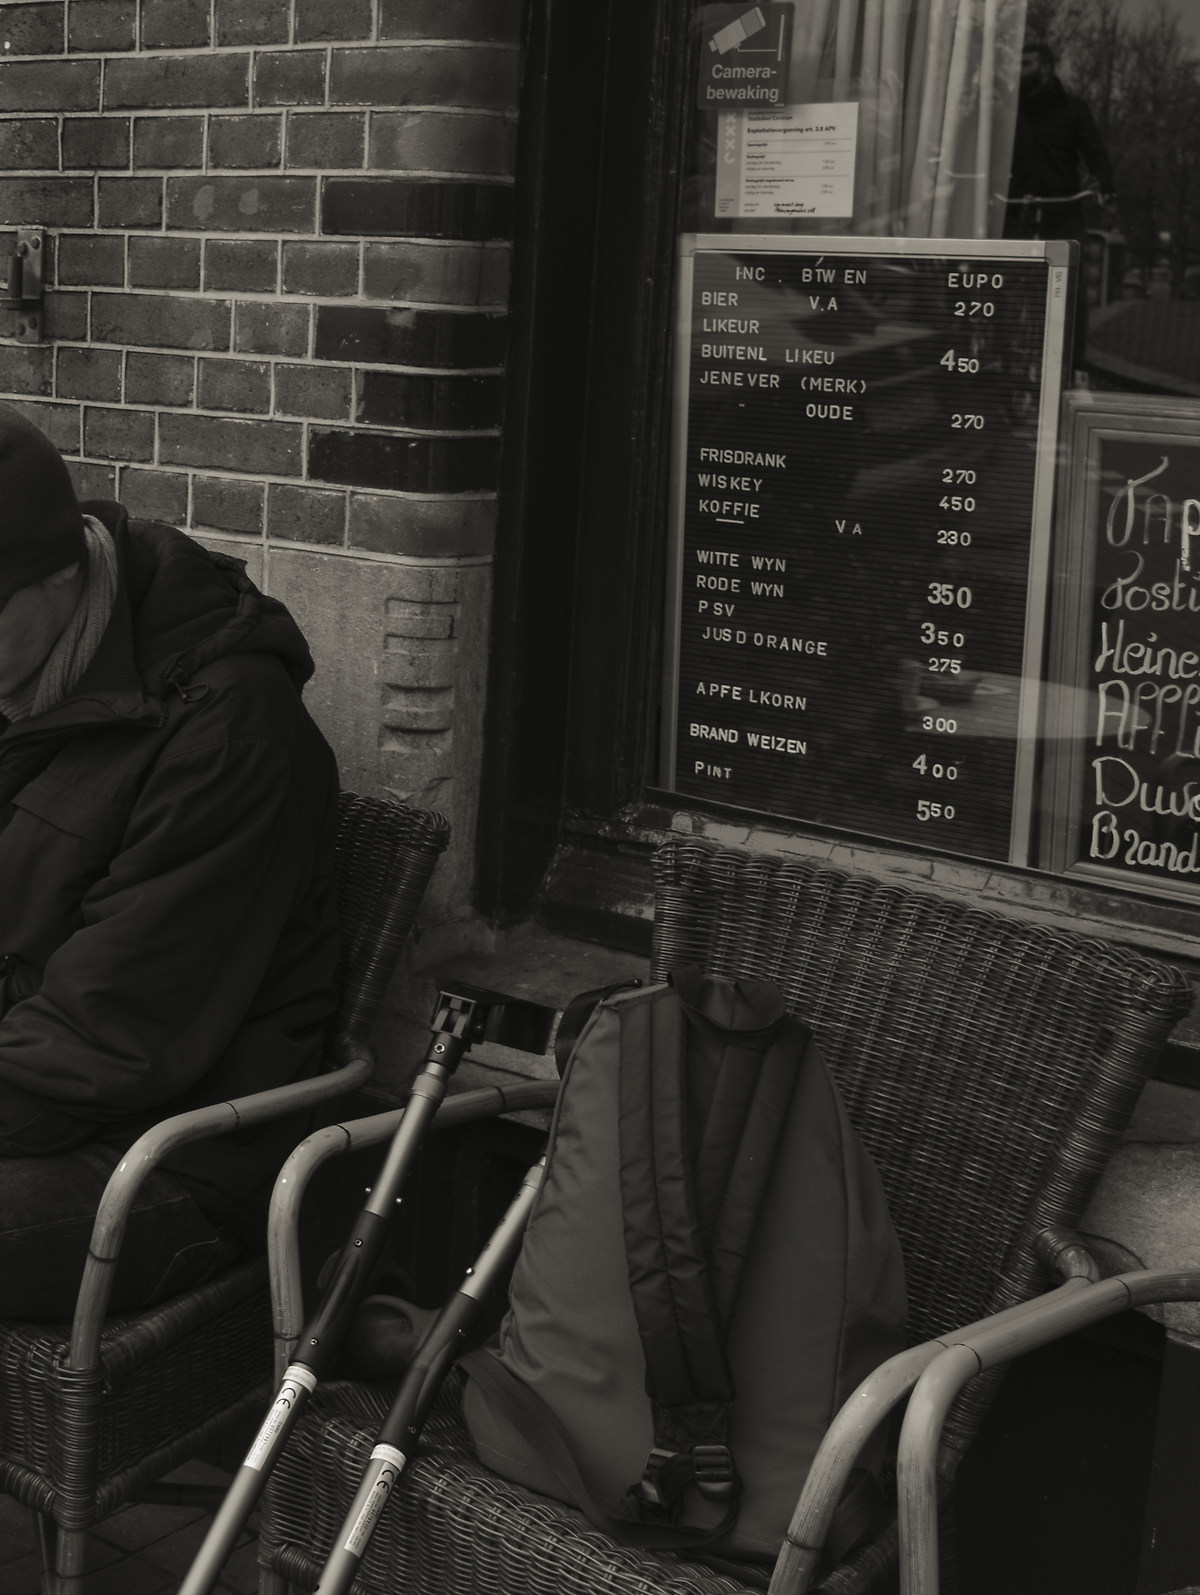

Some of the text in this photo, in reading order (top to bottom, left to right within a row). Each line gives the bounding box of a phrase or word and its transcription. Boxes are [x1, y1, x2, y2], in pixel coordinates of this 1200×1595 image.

[712, 64, 777, 78] Camera-
[706, 85, 779, 102] bewaking
[801, 268, 836, 283] BTW
[844, 269, 867, 285] EN
[701, 291, 738, 307] BIER
[953, 301, 995, 317] 270
[703, 318, 760, 334] LIKEUR
[701, 343, 980, 374] BUITENL LIKEU 450
[800, 376, 867, 394] (MERK)
[805, 403, 985, 430] OUDE 270
[700, 447, 977, 485] FRISDRANK 270
[698, 473, 976, 512] WISKEY 450
[699, 500, 760, 519] KOFFIE
[936, 529, 971, 547] 230
[696, 549, 972, 609] WITTE WYN 350
[696, 574, 965, 648] RODE WYN 350
[753, 632, 828, 656] ORANGE
[1095, 618, 1200, 679] Heine
[928, 657, 962, 675] 275
[923, 717, 957, 733] 300
[689, 723, 958, 780] BRAND WEIZEN 400
[916, 799, 955, 822] 550
